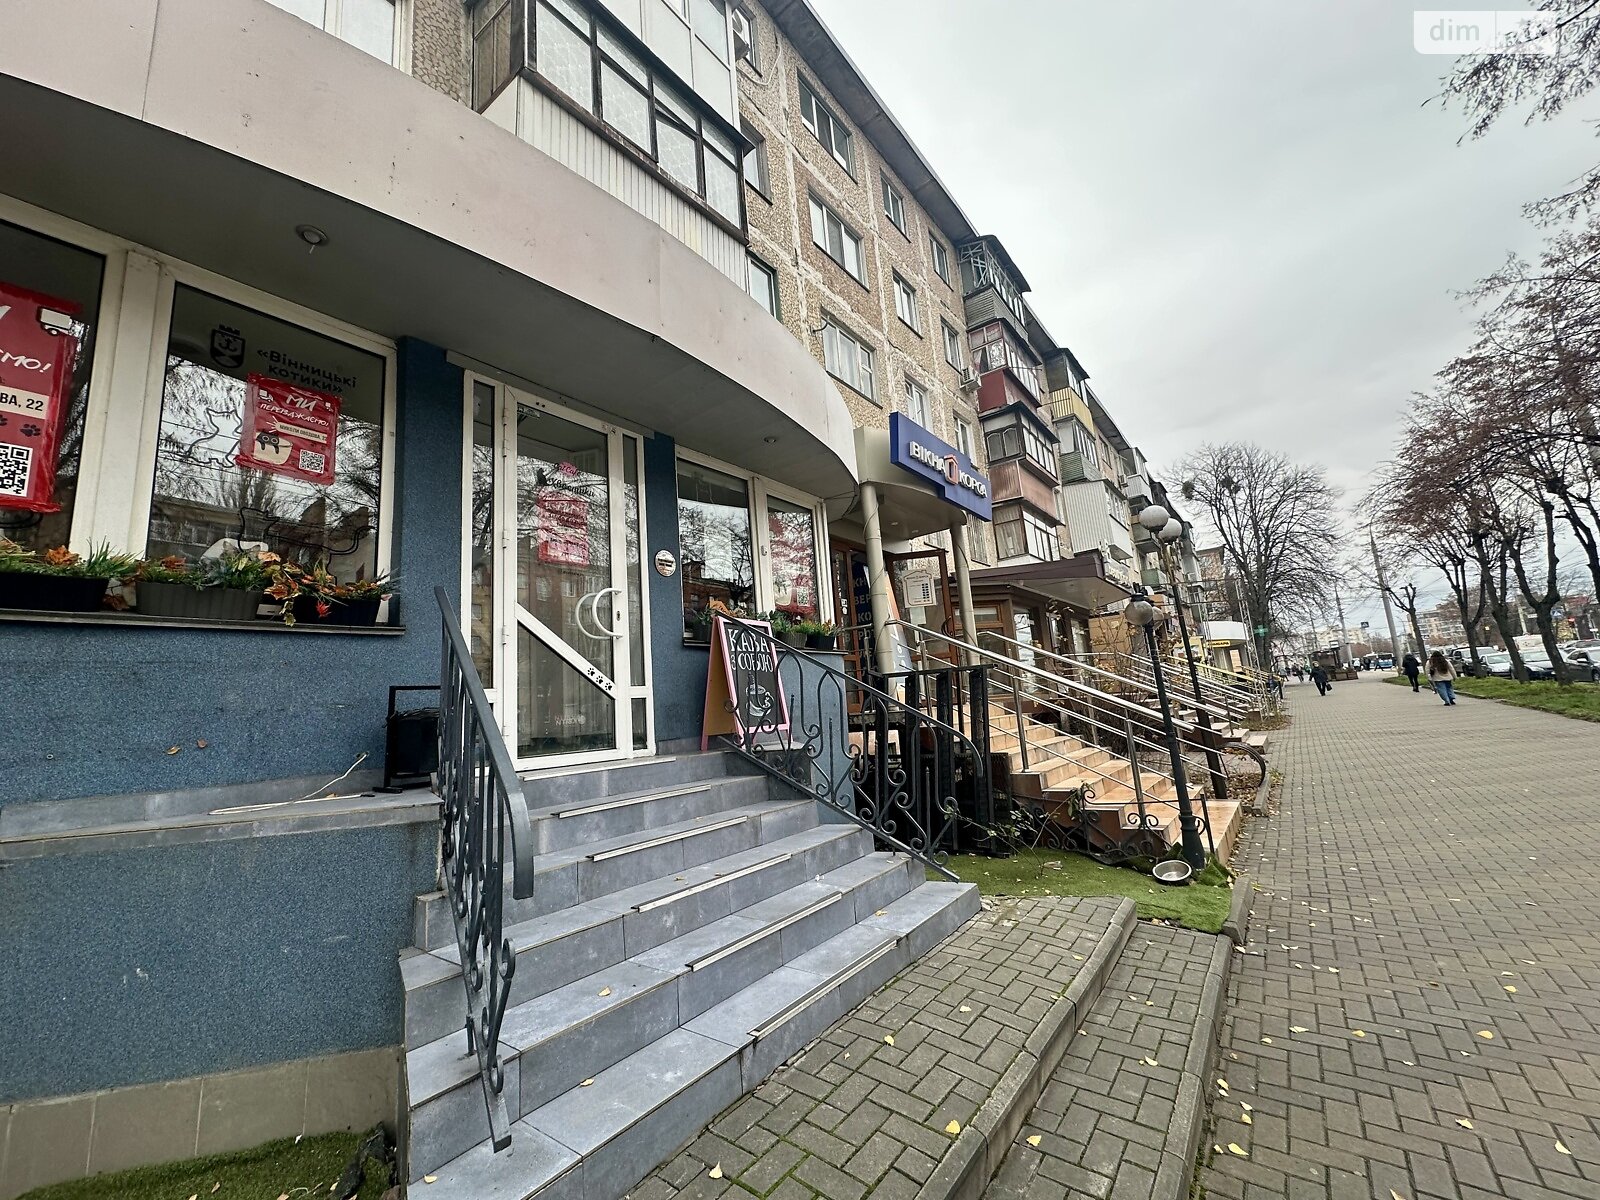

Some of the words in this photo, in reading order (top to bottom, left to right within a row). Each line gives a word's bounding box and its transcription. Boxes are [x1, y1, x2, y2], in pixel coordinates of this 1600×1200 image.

[256, 349, 357, 388] «Вінницькі
[268, 365, 343, 393] котики»
[25, 398, 44, 412] 22
[285, 394, 317, 412] МИ
[909, 441, 946, 473] ВІКНА
[958, 470, 988, 498] КОРСА
[728, 629, 771, 653] КАВА
